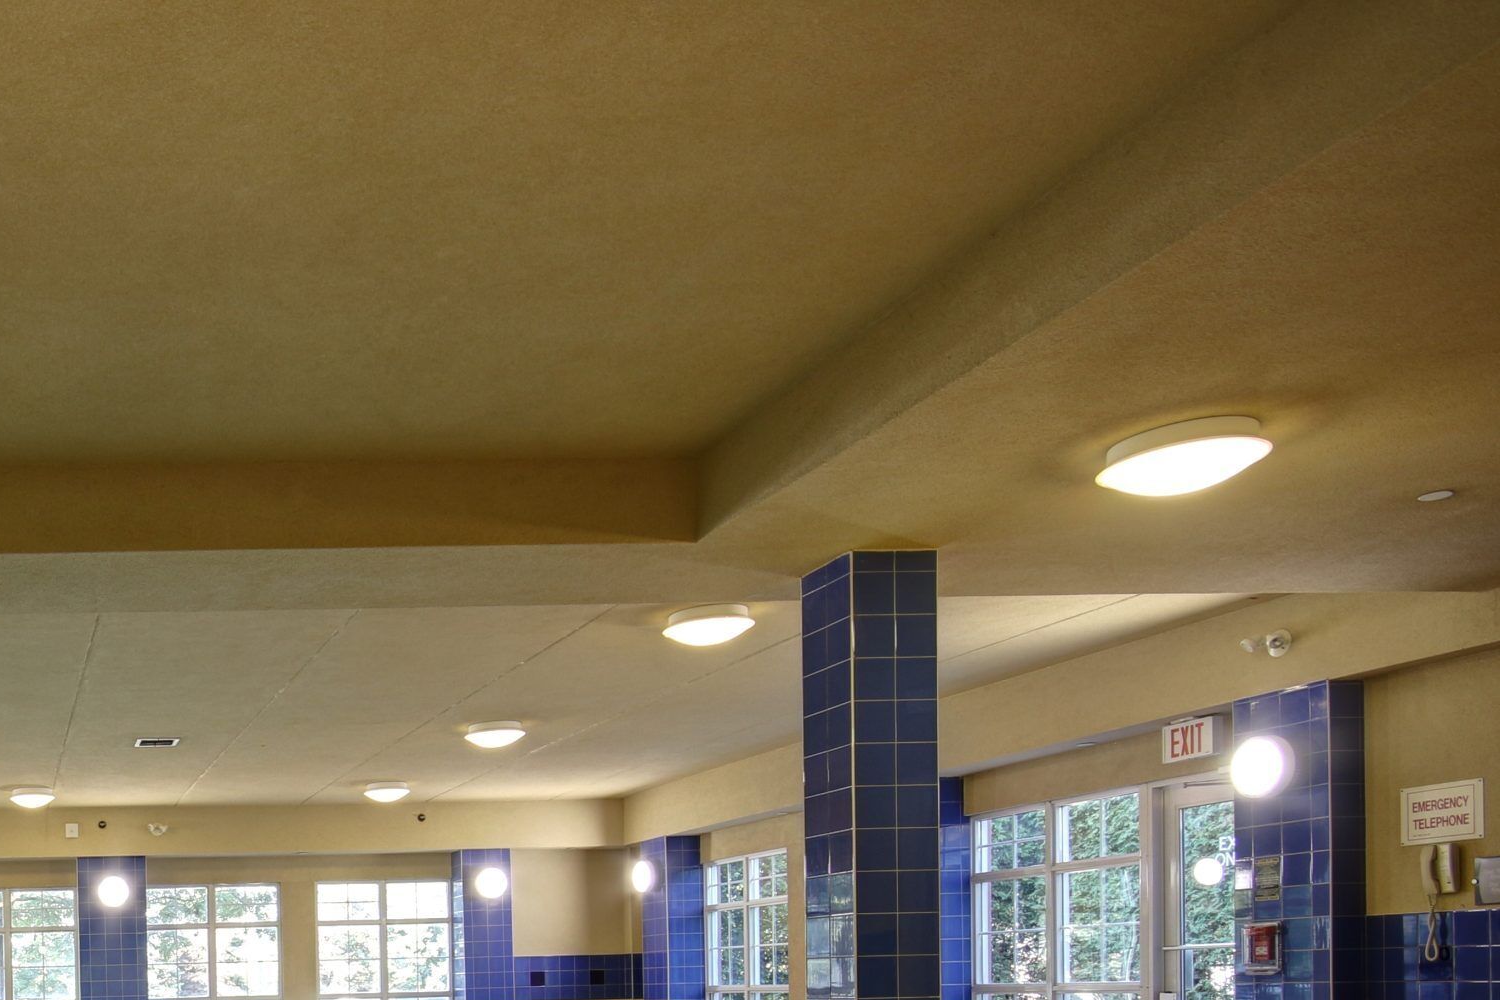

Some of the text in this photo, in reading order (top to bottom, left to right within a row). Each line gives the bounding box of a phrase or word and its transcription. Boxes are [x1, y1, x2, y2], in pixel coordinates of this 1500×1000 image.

[1170, 722, 1204, 758] EXIT
[1412, 795, 1469, 813] EMERGENCY
[1412, 813, 1470, 830] TELEPHONE
